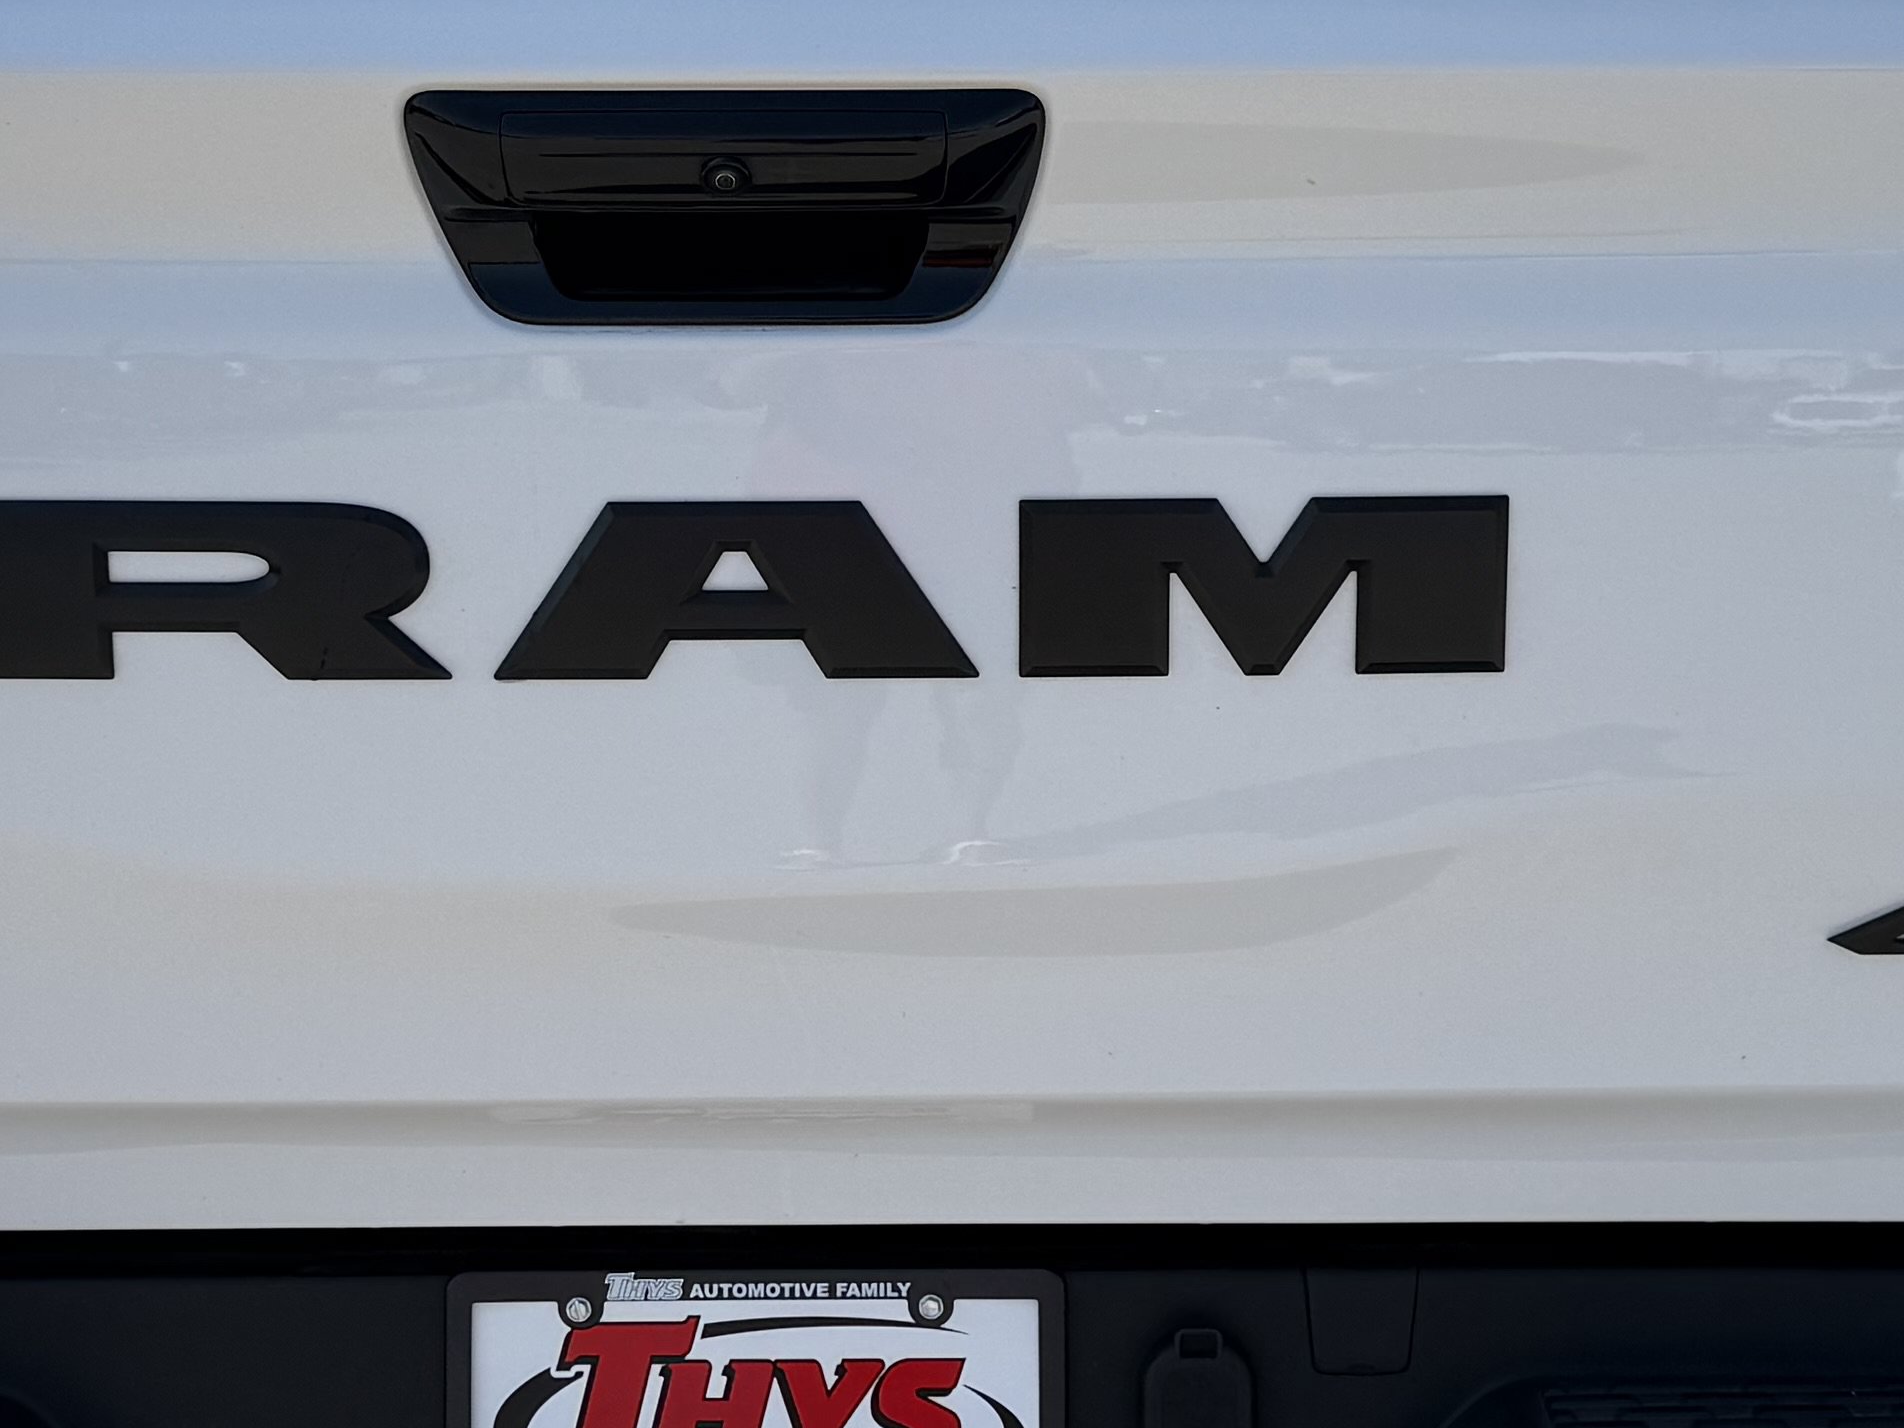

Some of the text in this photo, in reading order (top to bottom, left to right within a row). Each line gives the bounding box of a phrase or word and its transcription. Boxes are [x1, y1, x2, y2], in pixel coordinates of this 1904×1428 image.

[604, 1272, 912, 1301] THYS AUTOMOTIVE FAMILY
